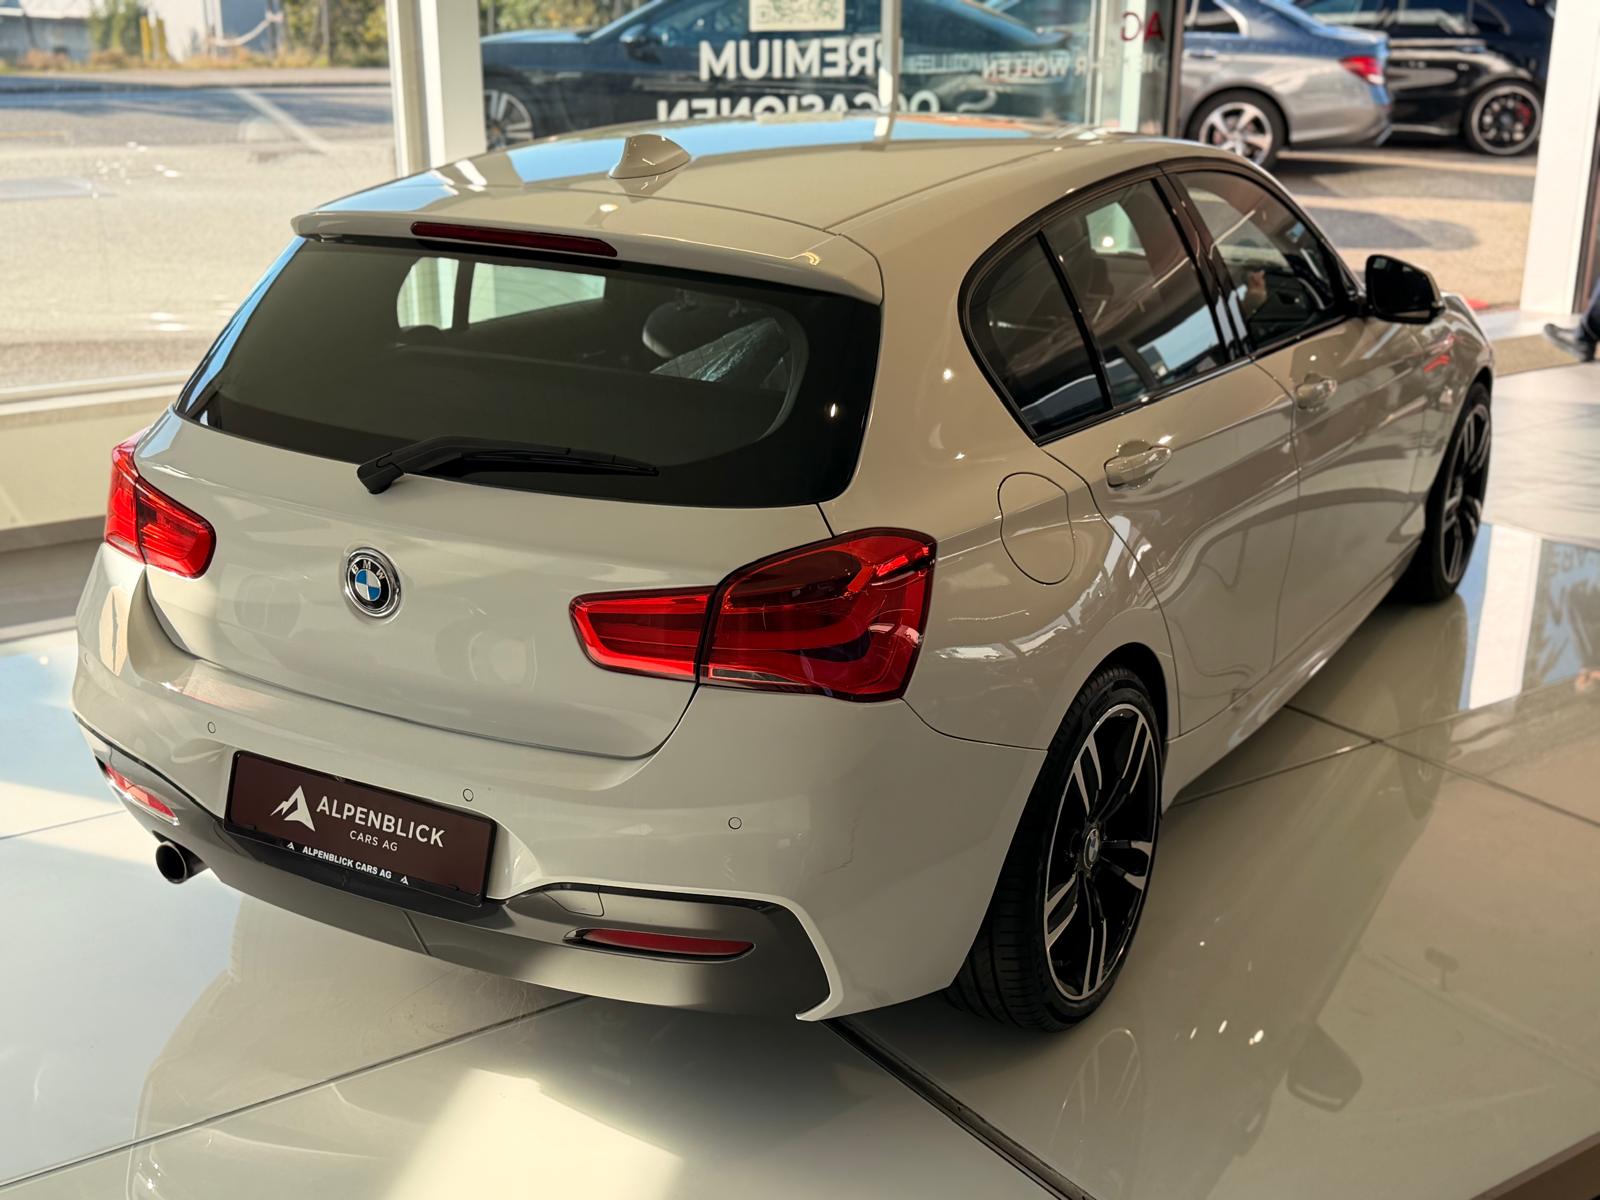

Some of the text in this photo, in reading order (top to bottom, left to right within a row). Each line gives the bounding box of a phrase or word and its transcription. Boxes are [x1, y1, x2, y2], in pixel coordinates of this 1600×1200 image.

[351, 559, 386, 580] BMW
[316, 796, 445, 847] ALPENBLICK
[349, 830, 399, 852] CARS AG
[302, 846, 393, 880] ALPENBLICK CARS AG
